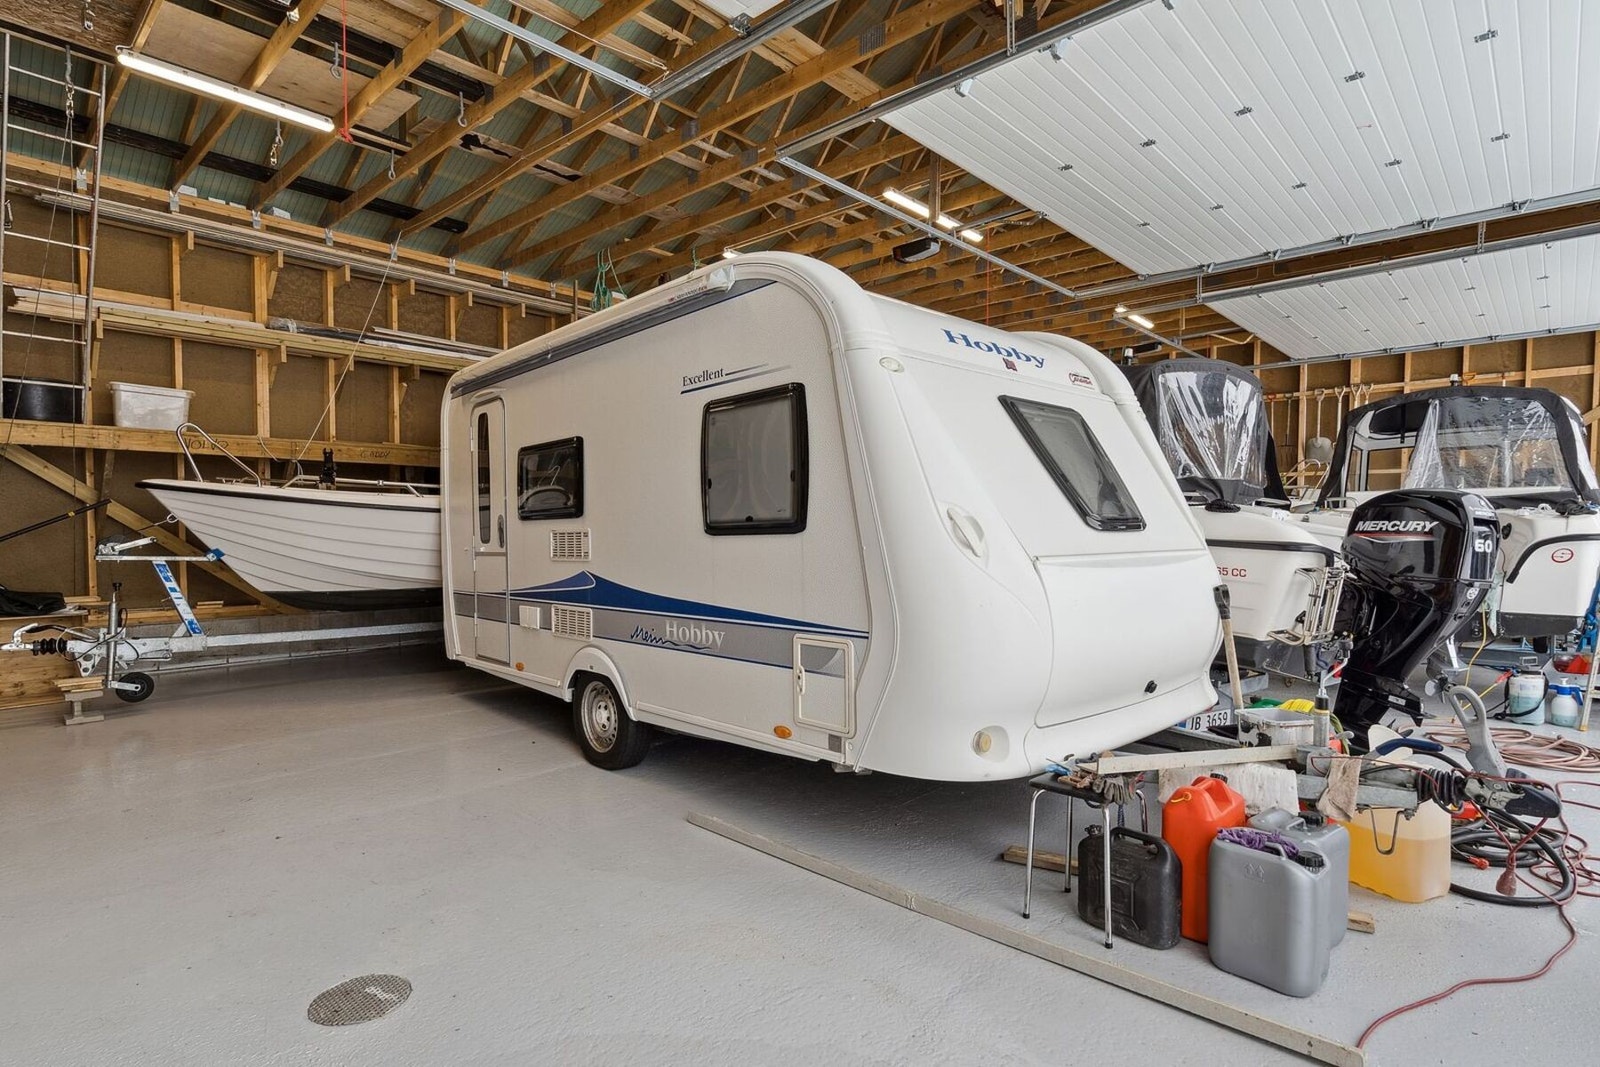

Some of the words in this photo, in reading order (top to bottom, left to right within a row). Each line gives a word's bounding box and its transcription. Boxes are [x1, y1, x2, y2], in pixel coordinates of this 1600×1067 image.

[940, 328, 1044, 369] Hobby
[682, 368, 724, 387] Excellent
[1354, 520, 1440, 532] MERCURY
[1474, 539, 1493, 553] 60
[1231, 568, 1247, 578] CC
[630, 624, 667, 645] Mein
[664, 619, 726, 650] Hobby
[1206, 711, 1228, 728] 3659
